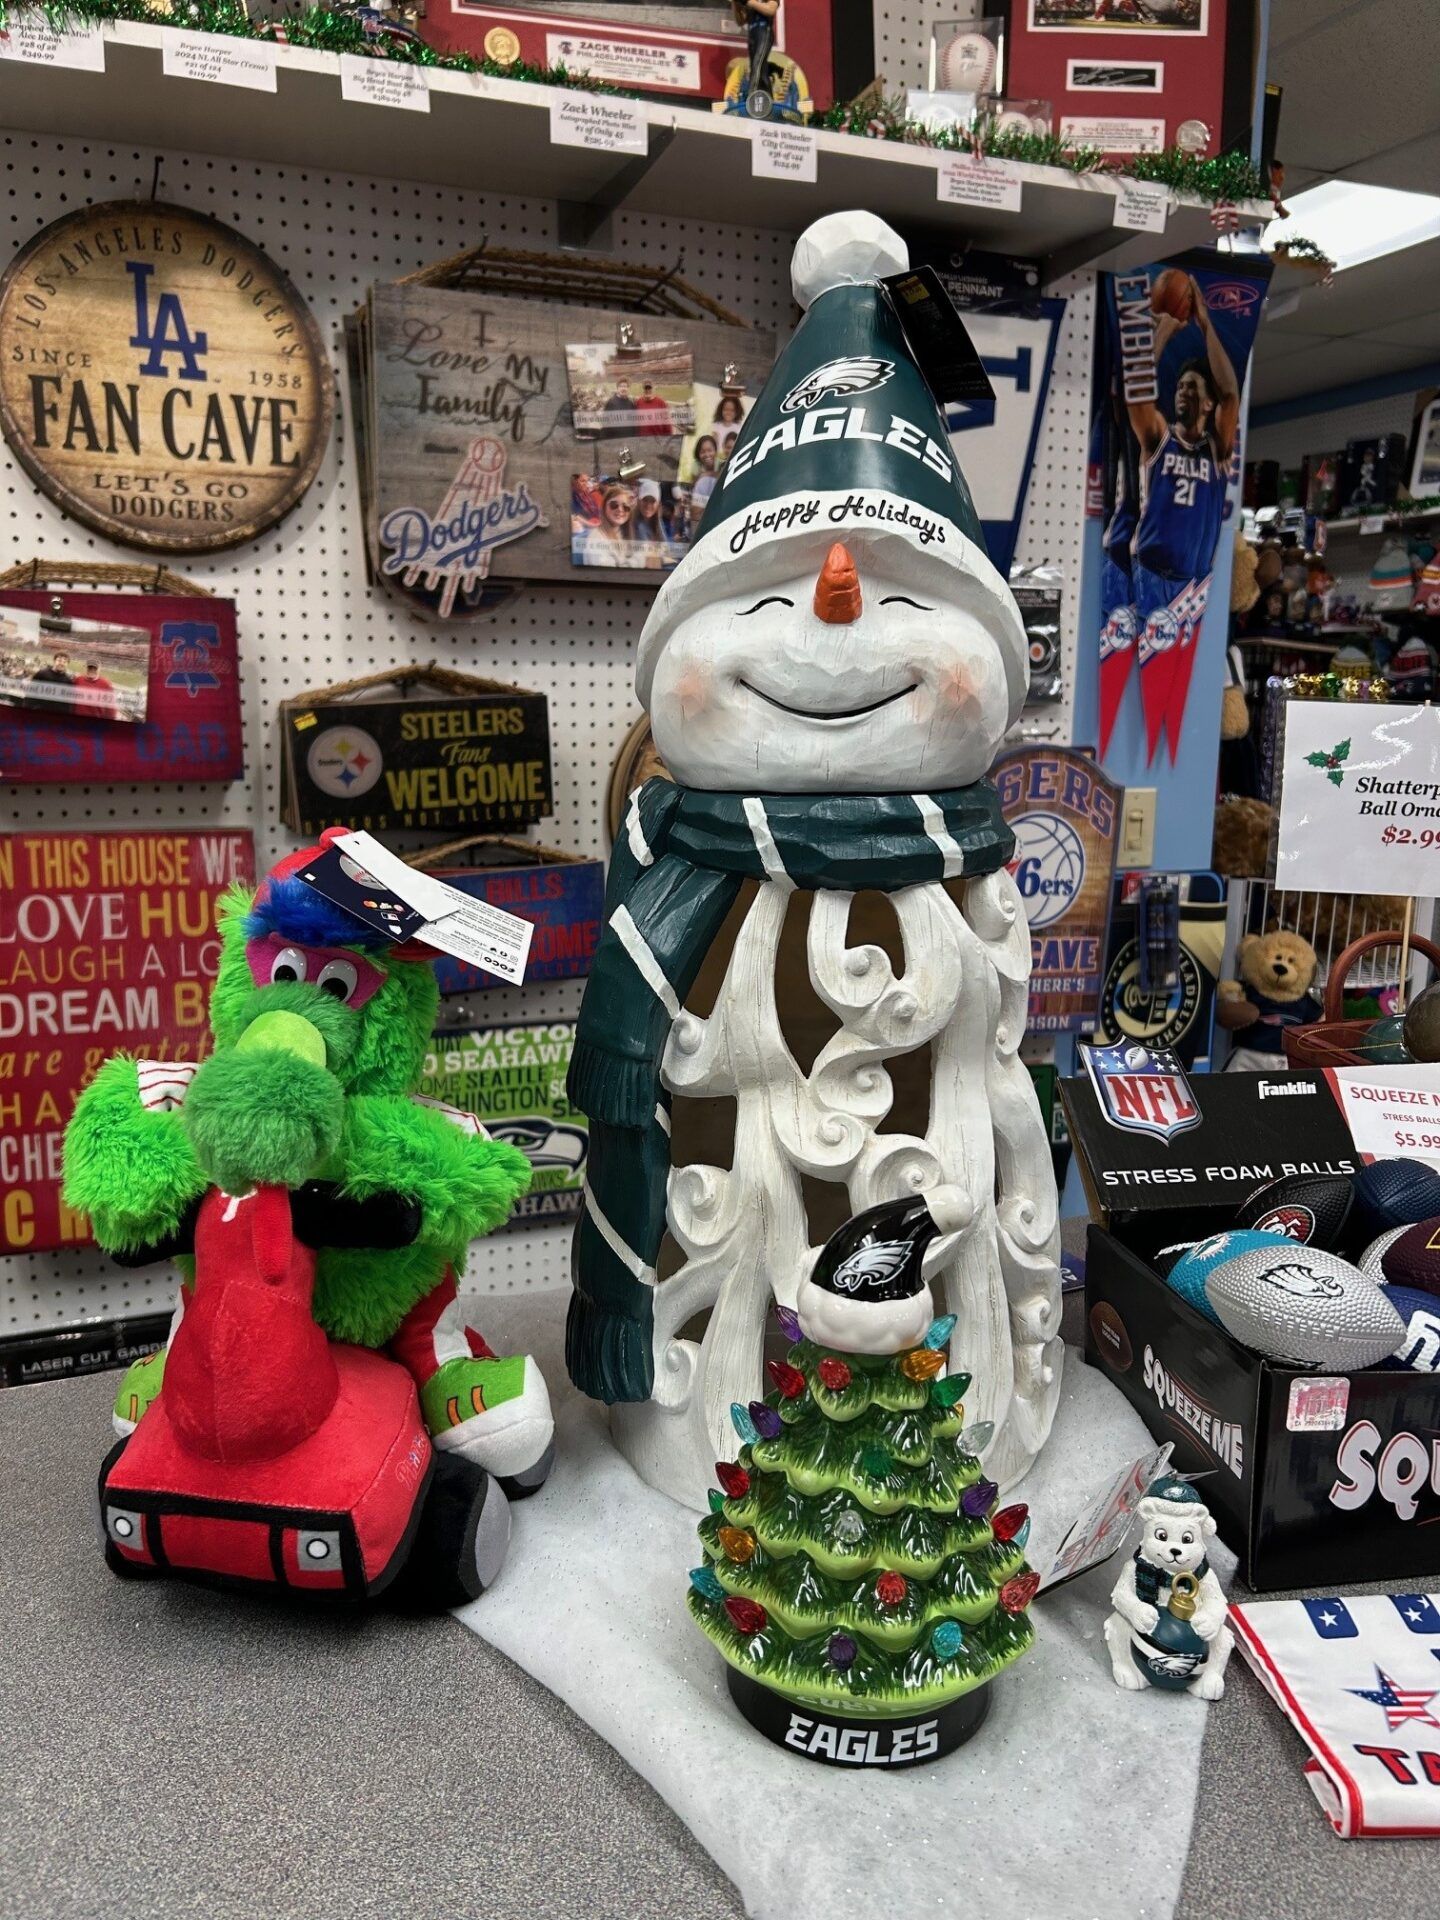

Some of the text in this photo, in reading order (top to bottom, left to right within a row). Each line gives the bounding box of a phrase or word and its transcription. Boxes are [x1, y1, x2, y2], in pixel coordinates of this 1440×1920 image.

[37, 42, 45, 51] of
[175, 51, 196, 60] 2024
[222, 57, 239, 66] Star
[180, 42, 232, 55] Bryce Harper
[576, 50, 634, 63] PHILADELPHIA
[635, 57, 671, 67] PHILLIES
[579, 41, 667, 59] ZACK WHEELER
[199, 62, 208, 70] of
[562, 102, 633, 121] Zack Wheeler
[16, 226, 304, 357] LOS ANGELES DODGERS
[947, 282, 1005, 298] PENNANT
[126, 261, 208, 382] LA
[470, 309, 495, 348] I
[1114, 273, 1159, 405] EMBIID
[12, 345, 93, 368] SINCE
[386, 318, 549, 394] Love My
[248, 370, 303, 389] 1958
[28, 374, 301, 469] FAN CAVE
[415, 372, 531, 443] Family
[722, 406, 953, 490] EAGLES
[1161, 452, 1211, 484] PHILA
[93, 472, 249, 499] LET'S GO
[1173, 478, 1197, 507] 21
[110, 495, 236, 523] DODGERS
[729, 495, 947, 554] Happy Holidays
[381, 485, 541, 572] Dodgers
[401, 707, 525, 741] STEELERS
[0, 721, 228, 767] BEST DAD
[439, 740, 492, 768] Fans
[385, 760, 545, 812] WELCOME
[303, 803, 551, 835] OTHERS NOT ALLOWED
[1358, 801, 1397, 817] Ball
[24, 838, 91, 889] THIS
[101, 837, 191, 888] HOUSE
[199, 836, 246, 886] WE
[486, 871, 564, 904] BILLS
[140, 889, 229, 939] HU
[0, 944, 125, 986] AUGH
[140, 943, 166, 979] A
[1029, 977, 1086, 992] HERE'S
[0, 979, 215, 1038] DREAM B
[466, 1067, 547, 1090] SEATTLE
[0, 1087, 79, 1128] HA
[442, 1086, 548, 1112] HINGTON
[1107, 1074, 1194, 1126] NFL
[1350, 1086, 1429, 1105] SQUEEZE
[1382, 1112, 1440, 1125] STRESS BALLS
[1394, 1130, 1440, 1149] $5.99
[1102, 1159, 1356, 1186] STRESS FOAM BALLS
[21, 1356, 74, 1374] LASER
[80, 1350, 111, 1365] CUT
[1143, 1344, 1243, 1479] SQUEEZE ME
[784, 1712, 939, 1764] EAGLES
